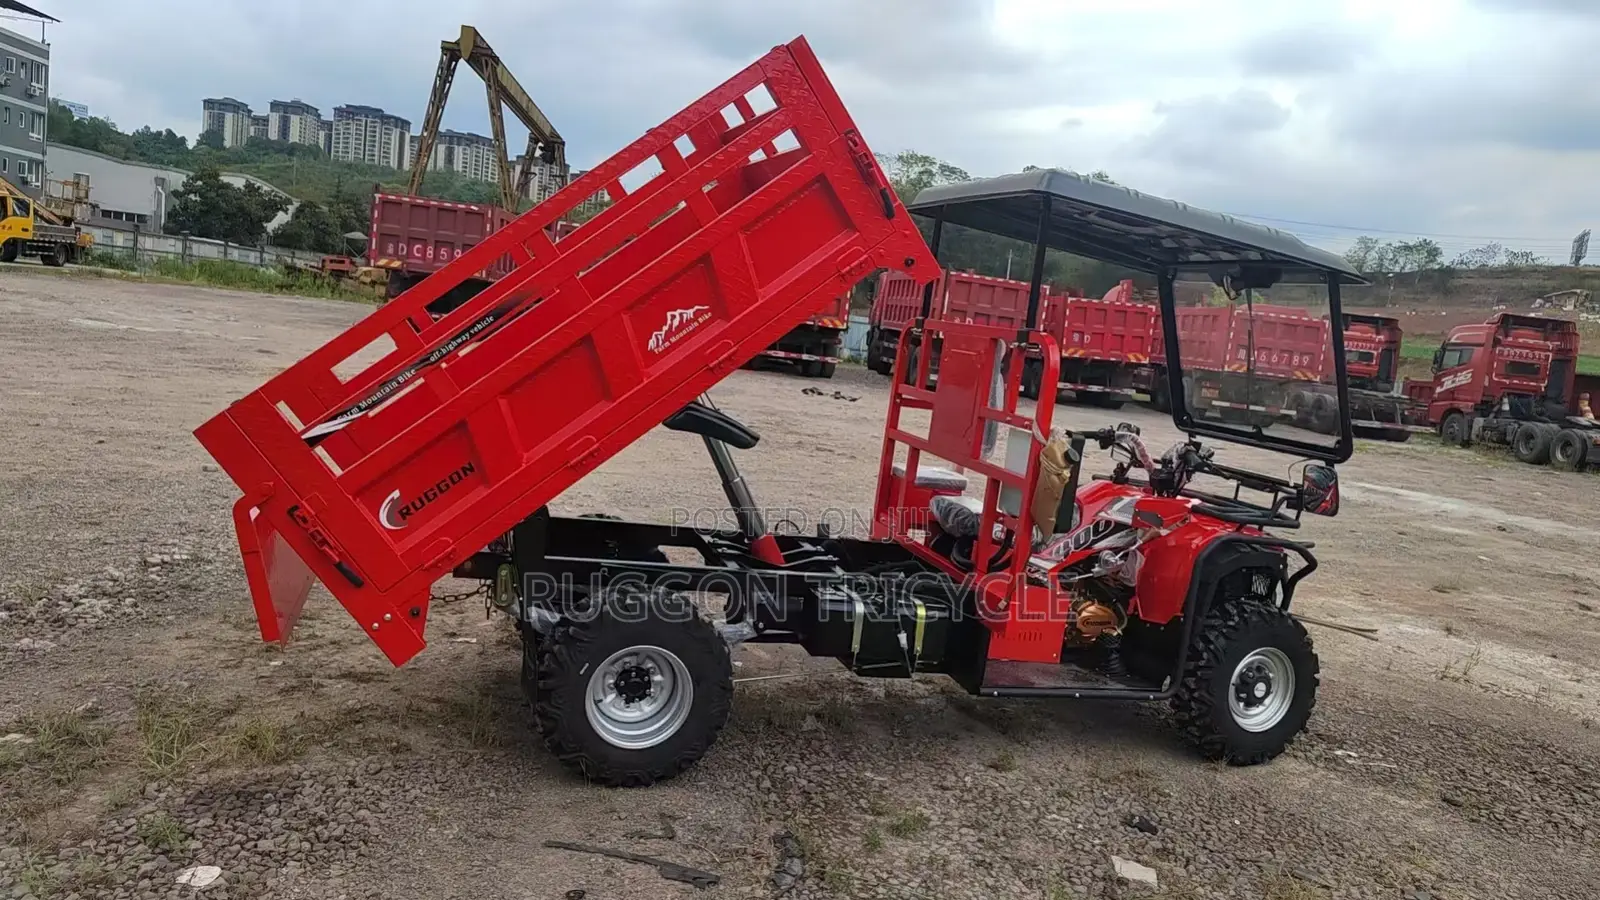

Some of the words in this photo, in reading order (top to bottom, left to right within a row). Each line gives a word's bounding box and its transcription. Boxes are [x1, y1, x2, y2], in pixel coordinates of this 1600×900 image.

[670, 322, 700, 343] Mountain
[698, 312, 712, 324] Bike
[360, 381, 399, 410] Mountain
[398, 368, 417, 385] Bike
[429, 332, 472, 363] off-highway
[469, 315, 495, 339] vehicle
[397, 461, 476, 521] RUGGON
[1052, 519, 1115, 562] 400
